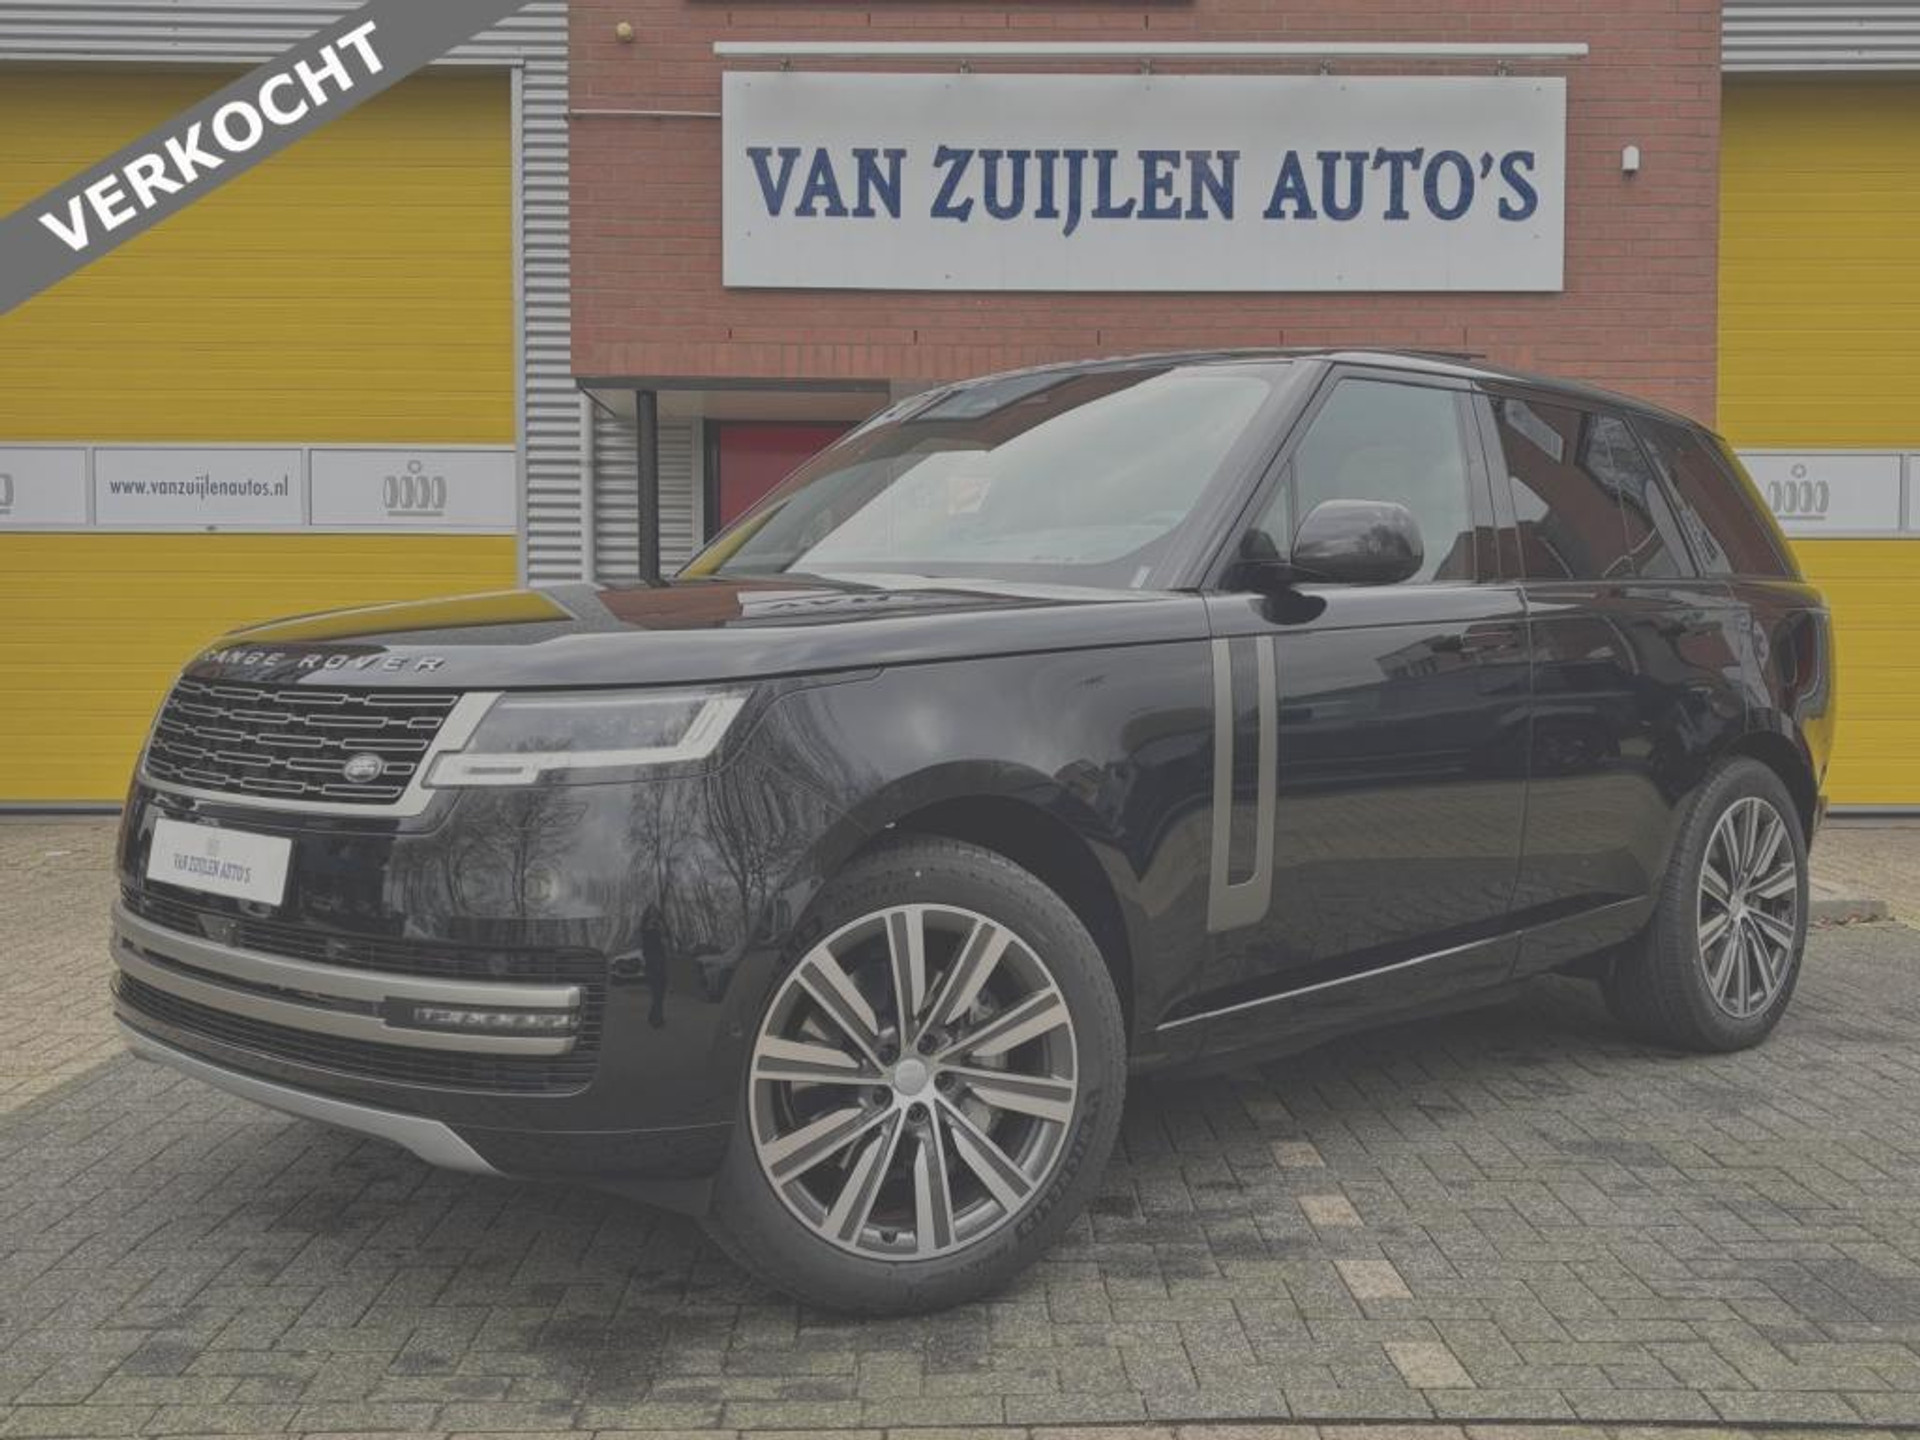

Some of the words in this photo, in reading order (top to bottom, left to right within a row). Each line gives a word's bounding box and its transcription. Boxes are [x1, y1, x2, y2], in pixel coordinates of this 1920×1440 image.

[746, 146, 908, 219] VAN
[930, 144, 1241, 238] ZUIJLEN
[1262, 146, 1540, 222] AUTO'S
[109, 474, 289, 500] www.vanzuijlenautos.nl
[297, 653, 447, 673] ROVER
